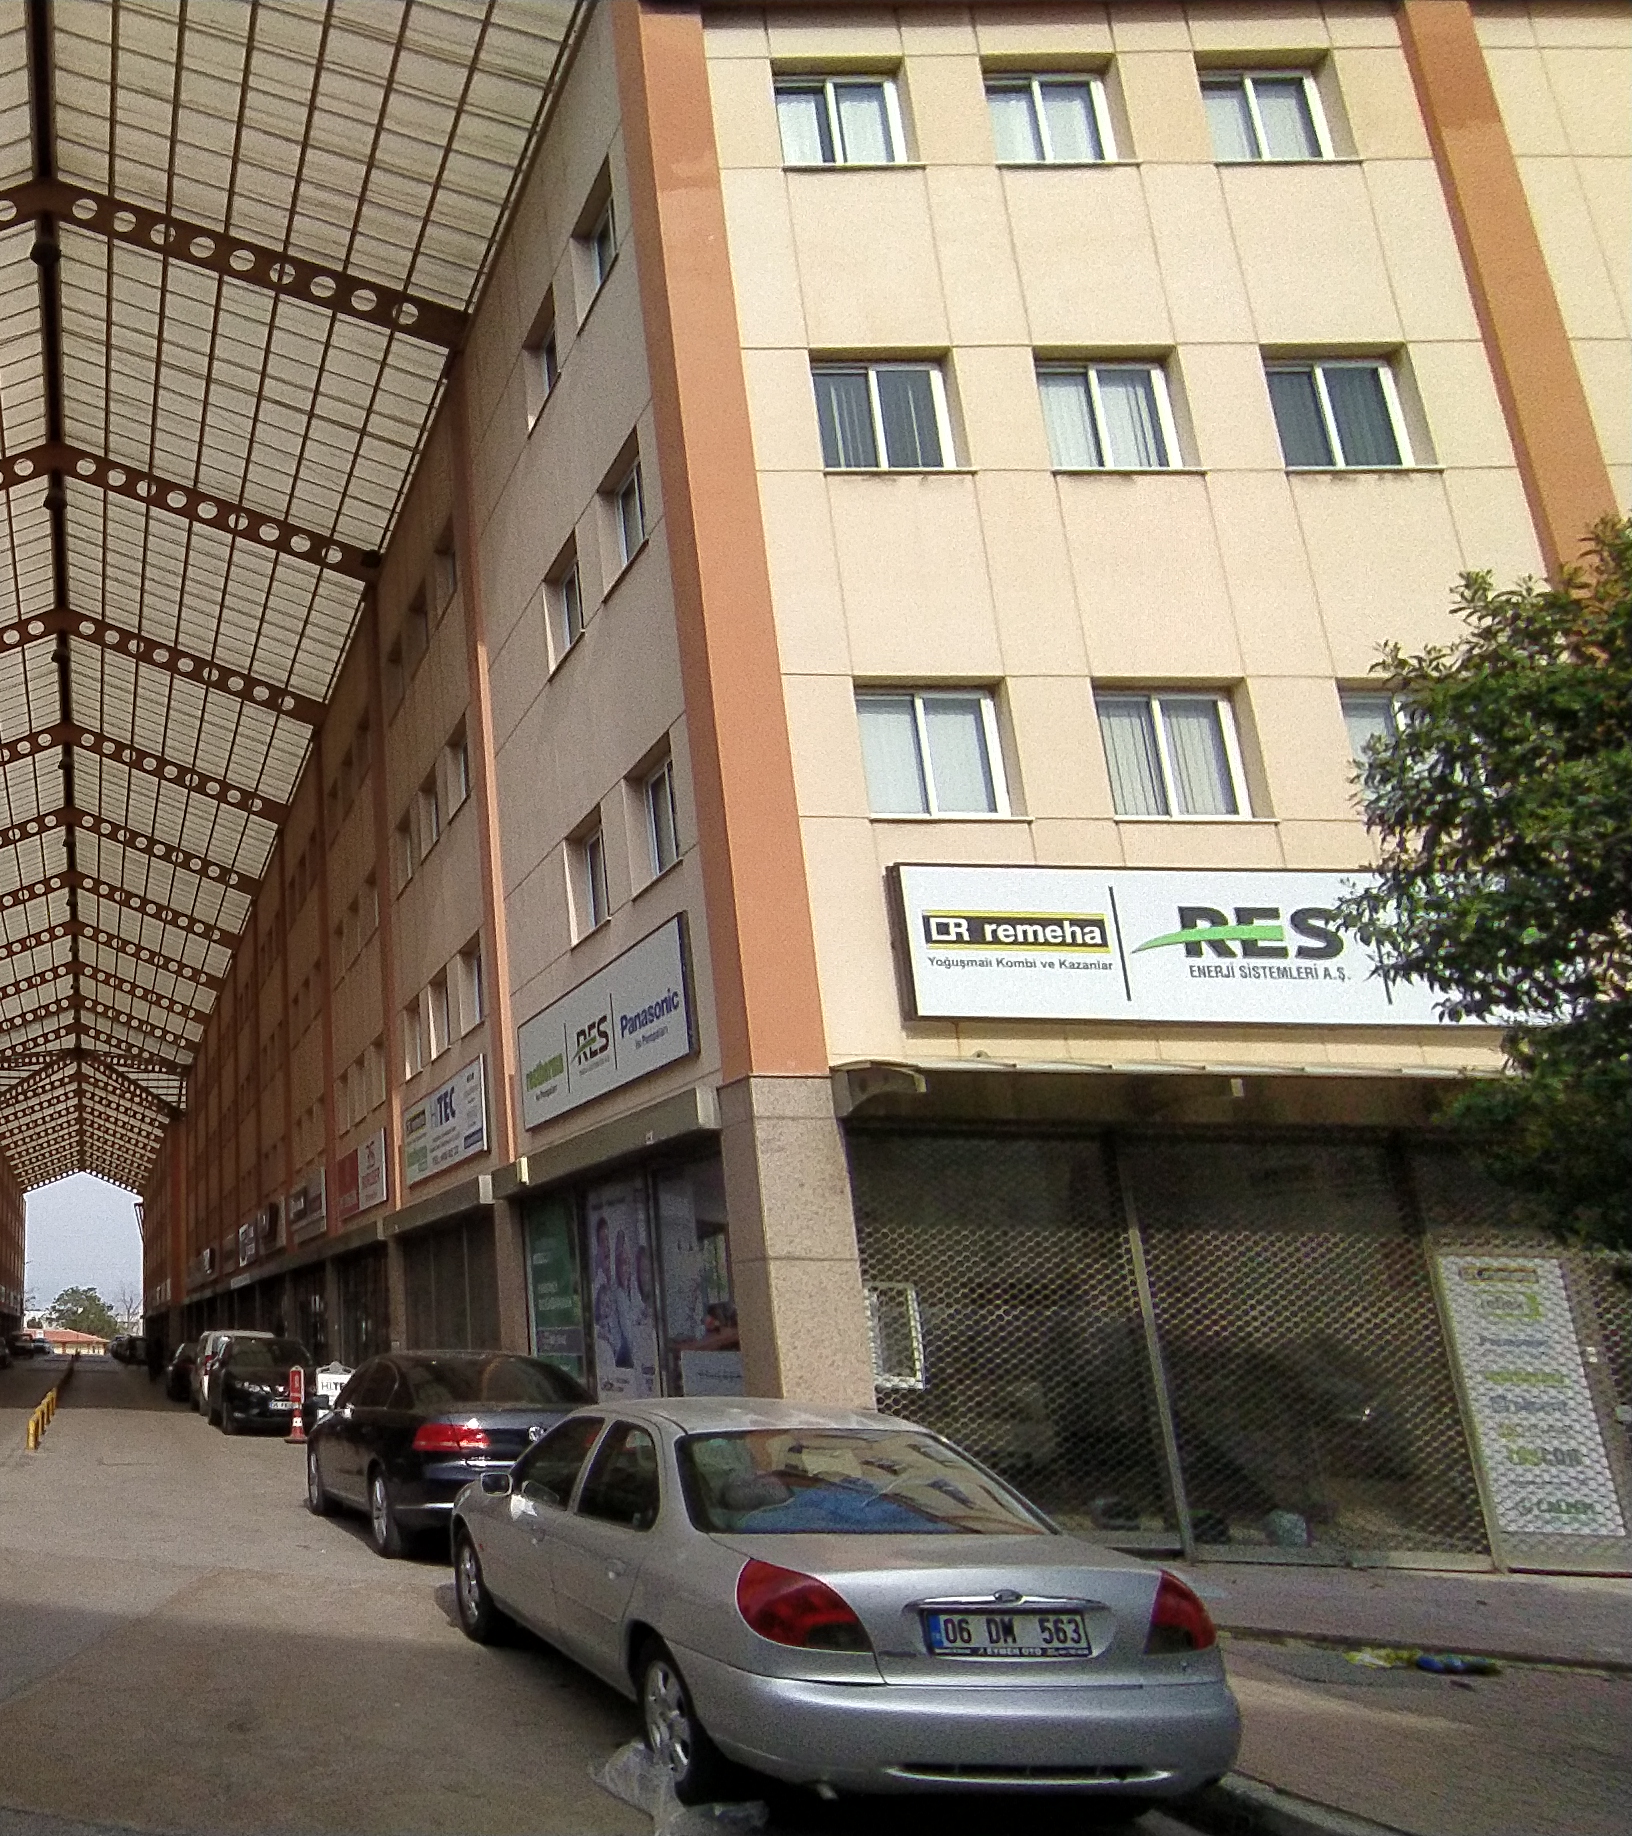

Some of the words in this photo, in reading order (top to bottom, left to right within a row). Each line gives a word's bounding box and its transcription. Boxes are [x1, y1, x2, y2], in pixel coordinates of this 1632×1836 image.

[983, 920, 1103, 944] remeha
[1177, 906, 1345, 960] RES
[995, 957, 1037, 969] Kombi
[1040, 961, 1056, 969] ve
[1059, 959, 1113, 971] Kazanlar
[1239, 963, 1319, 980] SİSTEMLERİ
[620, 988, 680, 1039] Panasonic
[575, 1014, 610, 1066] RES
[943, 1617, 972, 1644] 06
[985, 1617, 1017, 1645] DM
[1038, 1617, 1082, 1645] 563
